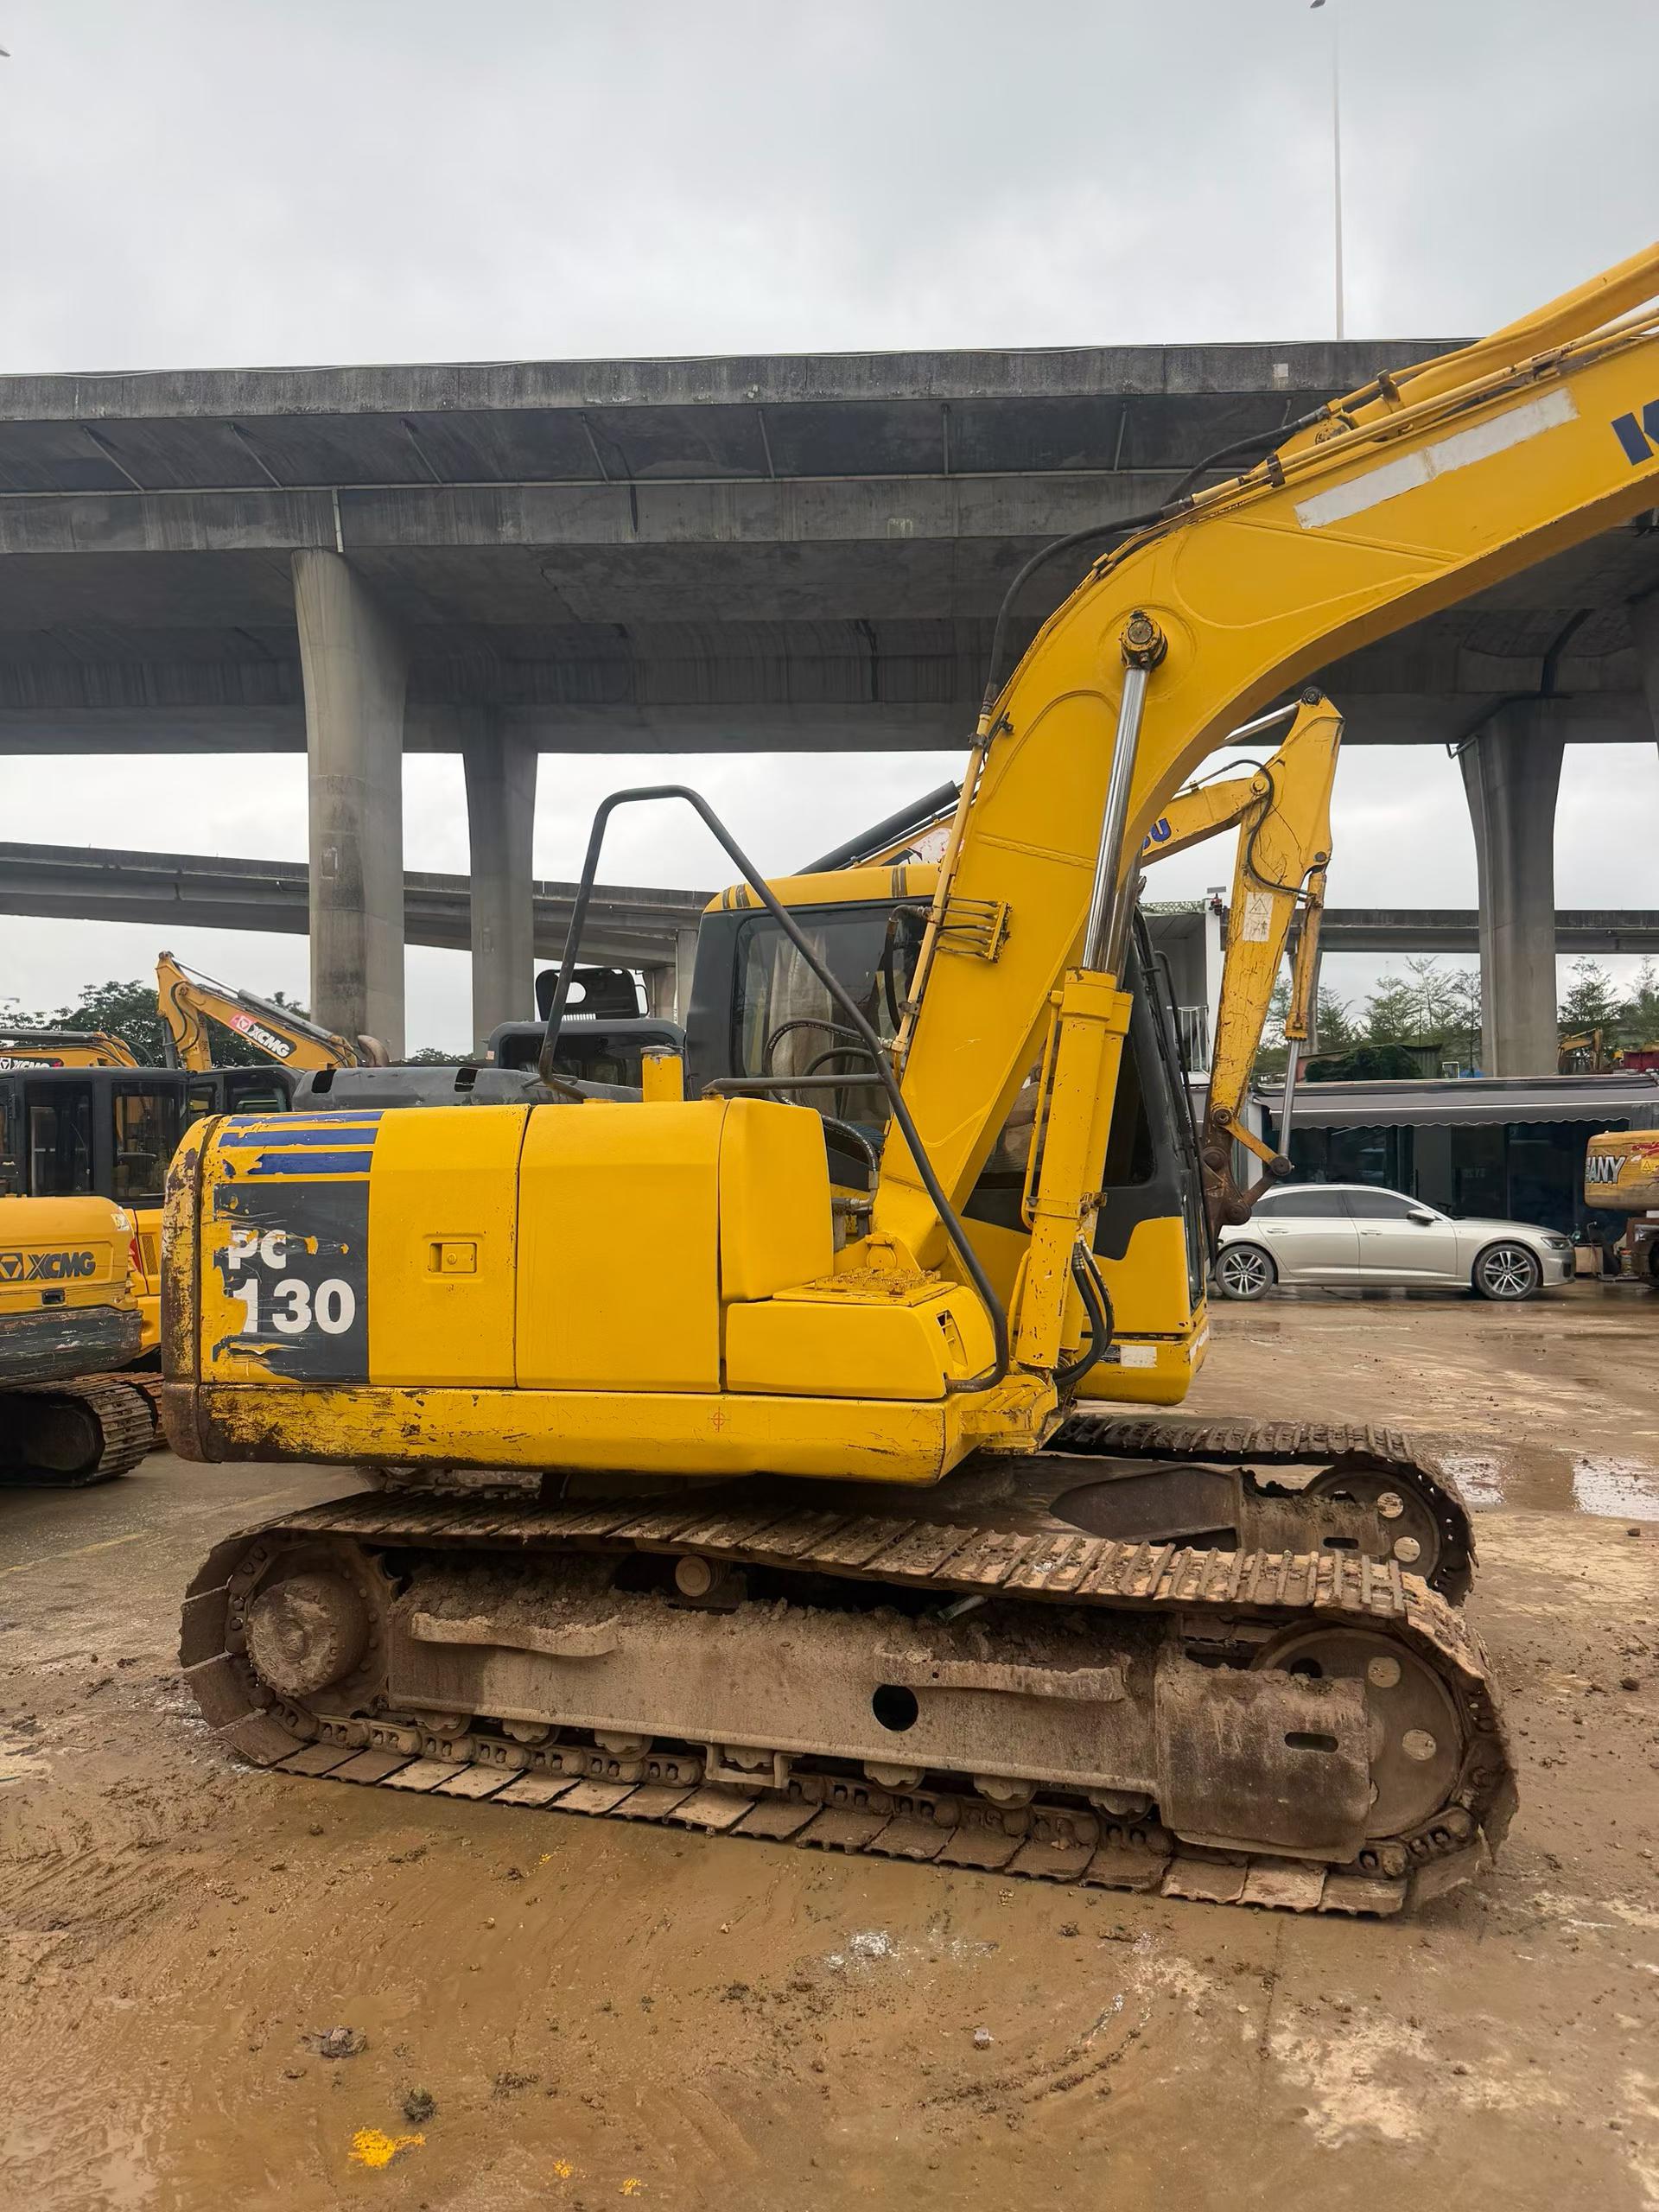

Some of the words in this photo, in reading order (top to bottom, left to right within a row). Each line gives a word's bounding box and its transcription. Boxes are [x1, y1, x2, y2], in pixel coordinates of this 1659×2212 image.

[247, 1024, 290, 1057] XCMG
[25, 1251, 96, 1280] XCMG
[228, 1229, 286, 1269] PC
[232, 1278, 355, 1334] 130
